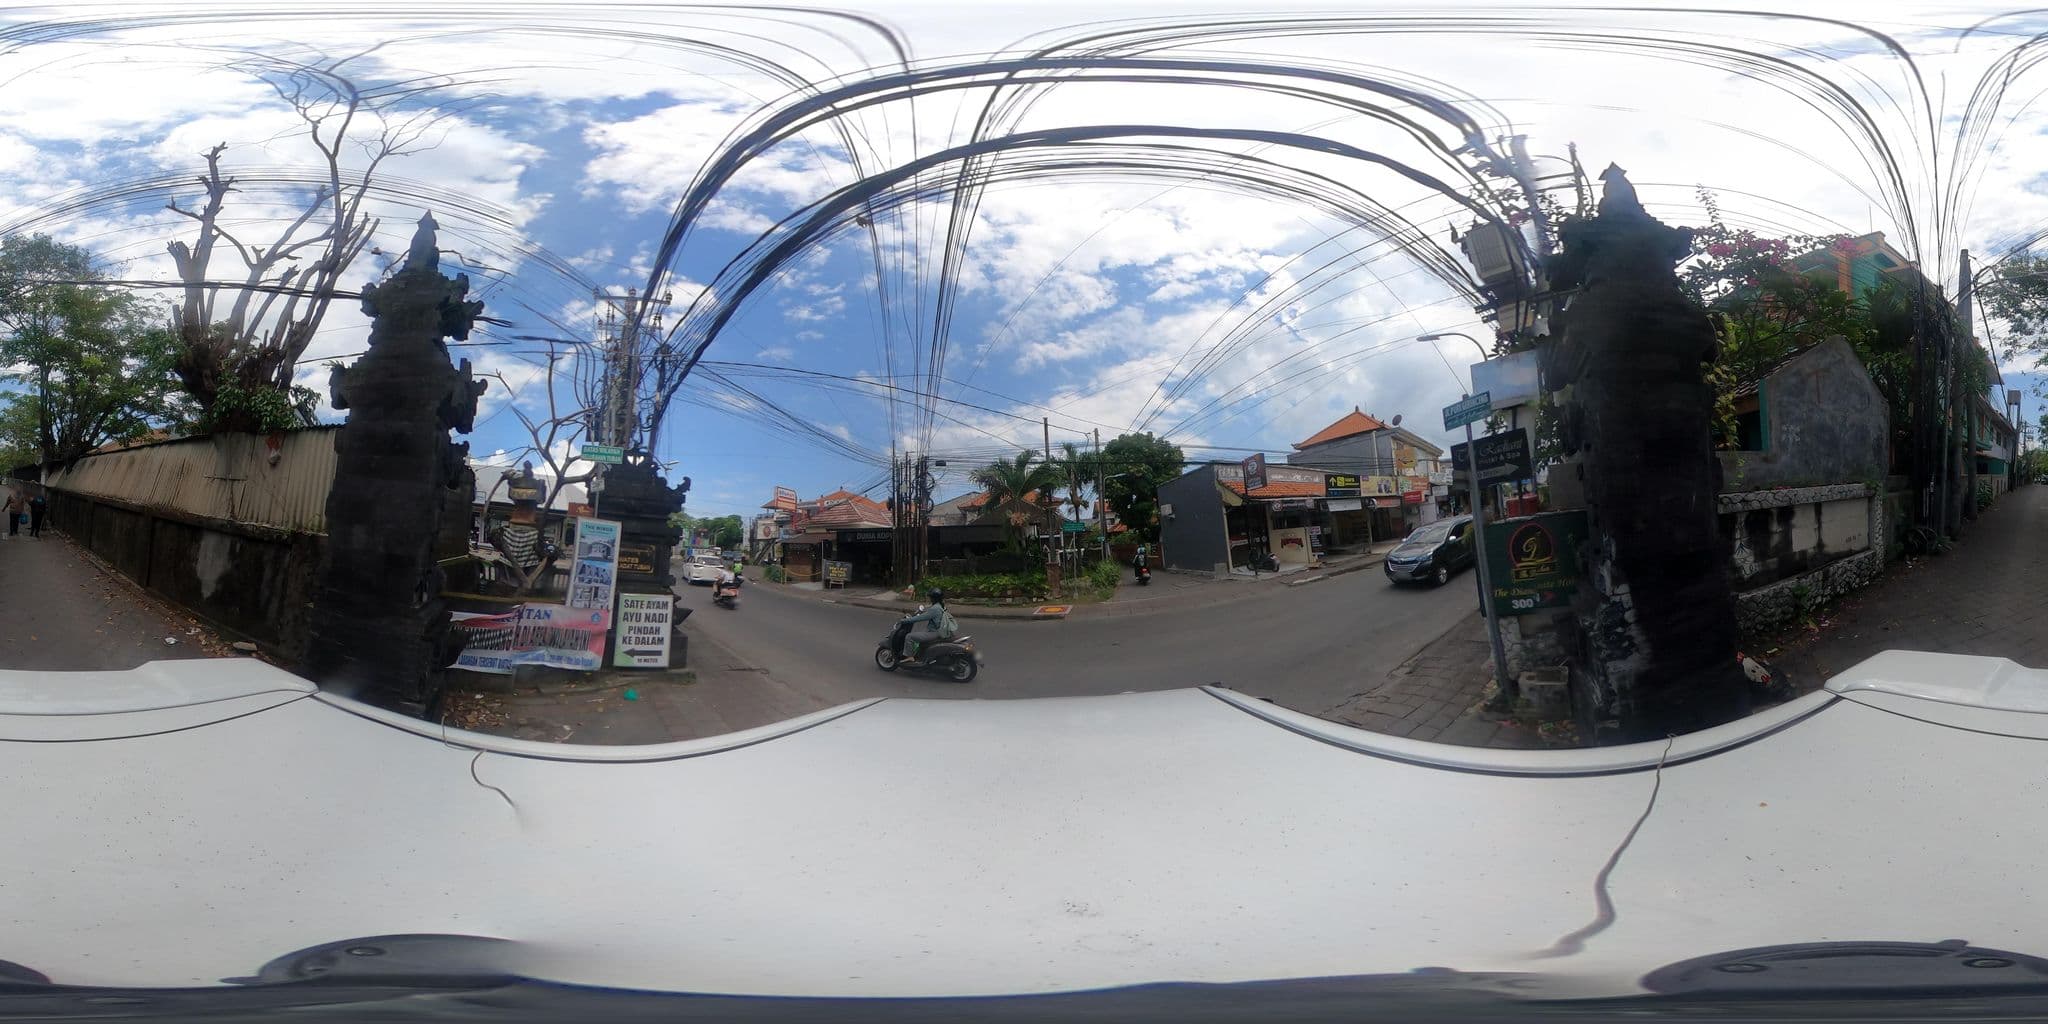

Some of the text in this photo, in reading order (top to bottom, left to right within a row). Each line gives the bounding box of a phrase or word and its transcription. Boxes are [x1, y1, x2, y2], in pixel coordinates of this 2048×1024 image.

[624, 599, 669, 610] SATE AYAM
[1512, 599, 1534, 609] 300
[622, 613, 668, 624] AYU NADI
[628, 626, 660, 635] PINDAH
[622, 636, 664, 646] KE DALAM
